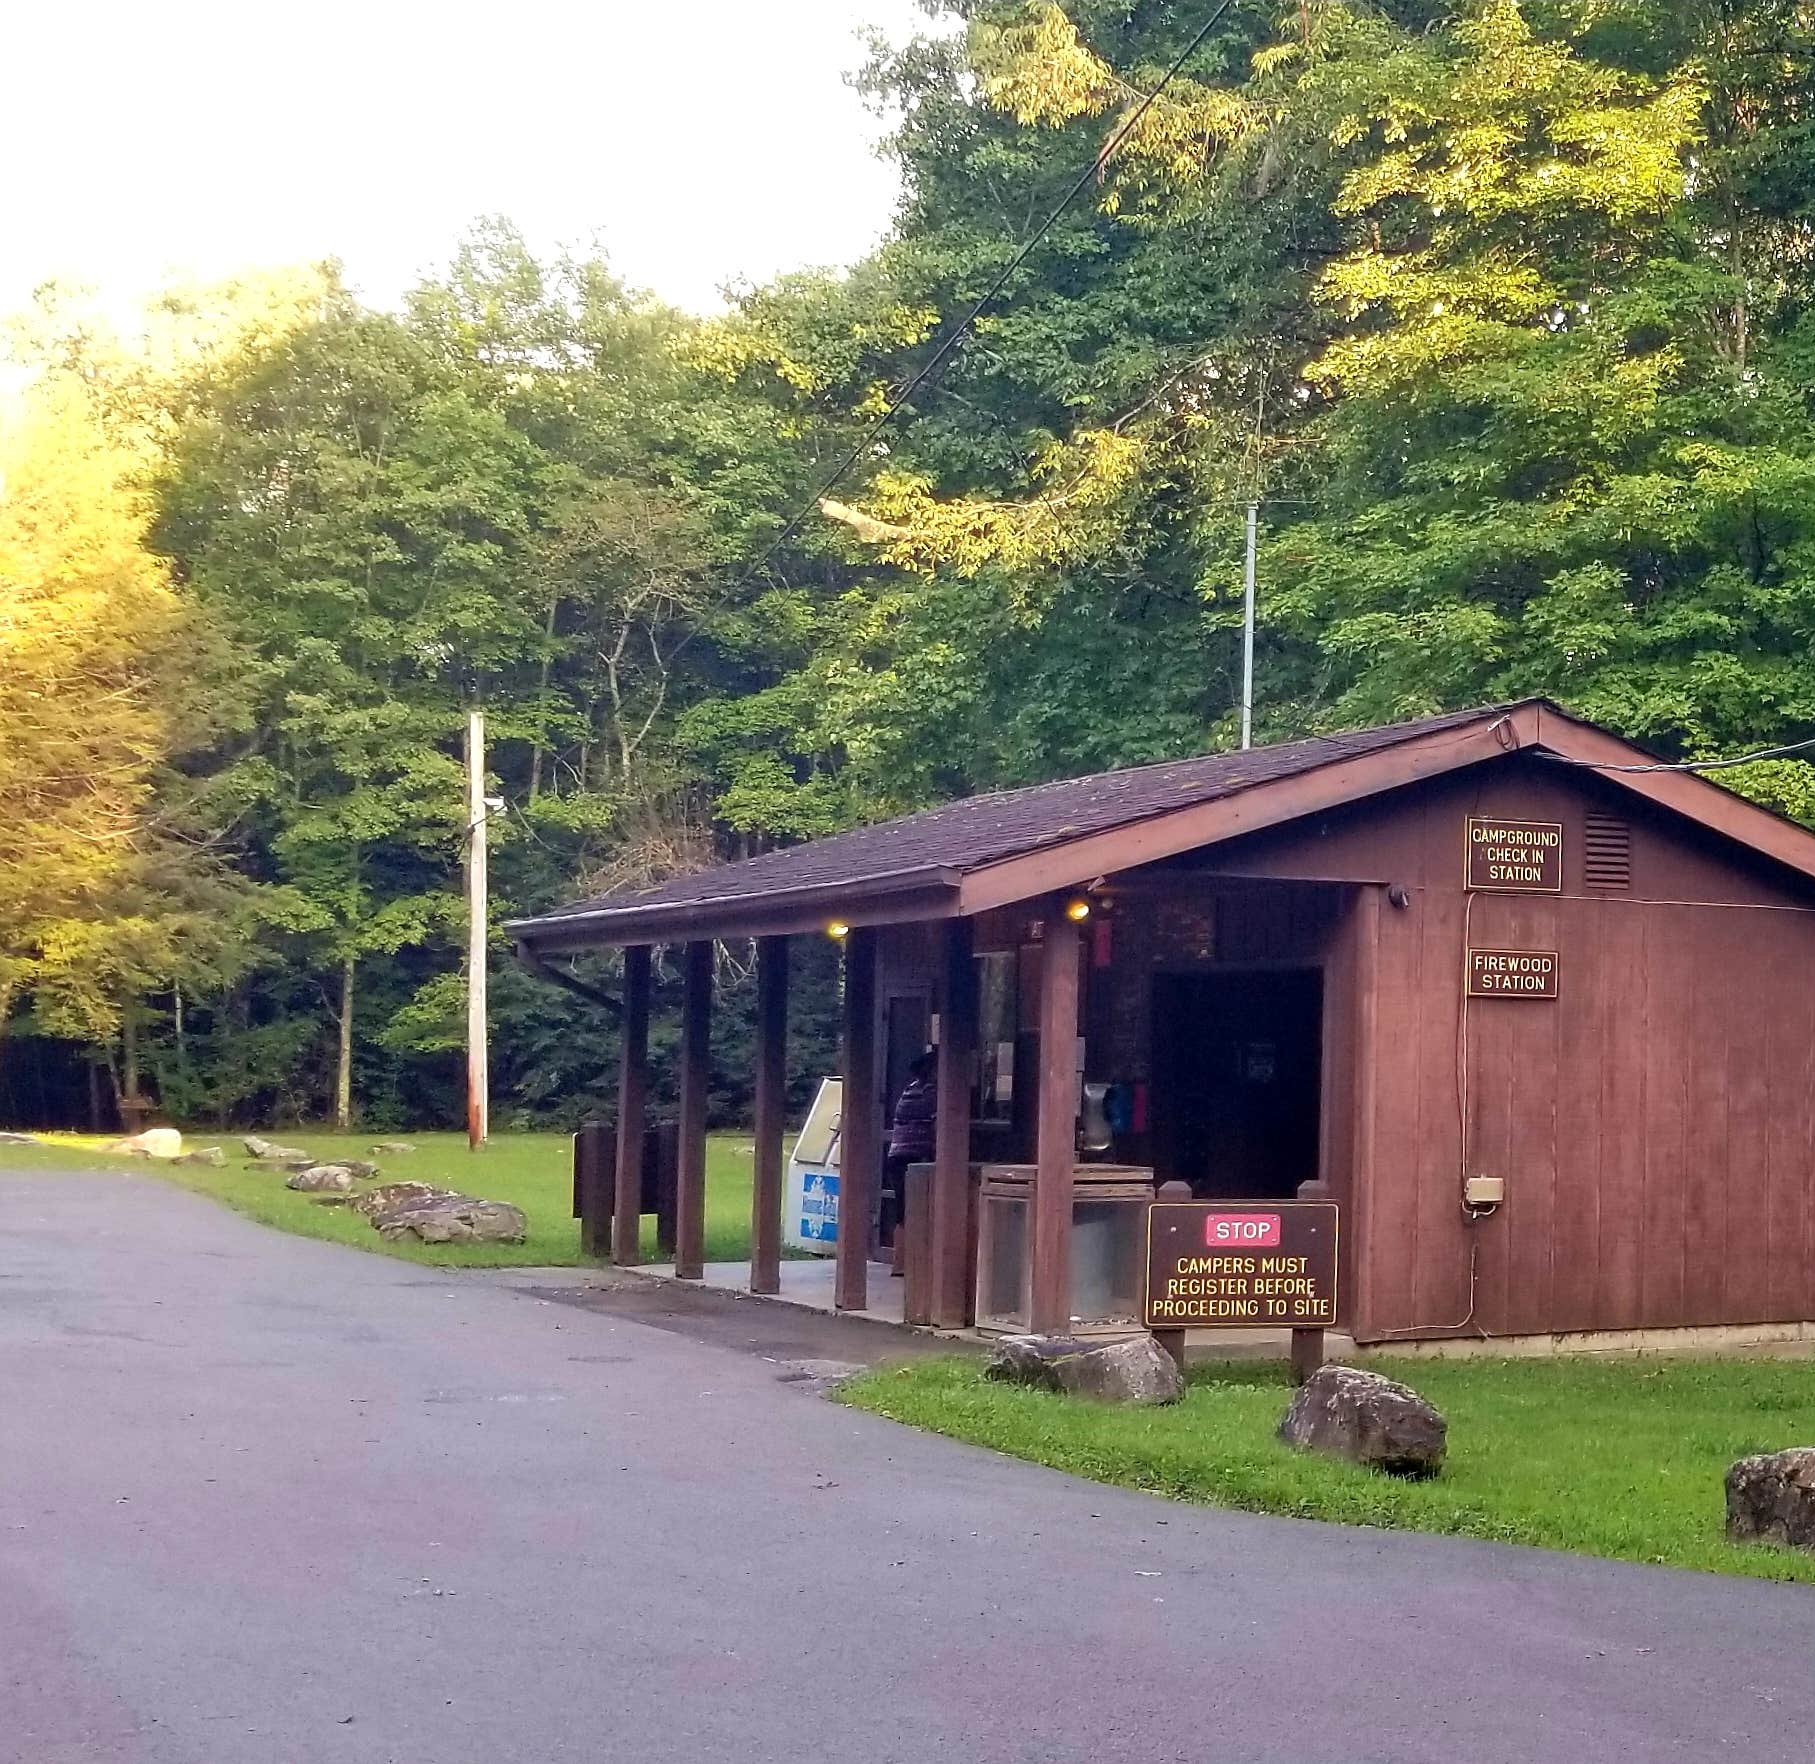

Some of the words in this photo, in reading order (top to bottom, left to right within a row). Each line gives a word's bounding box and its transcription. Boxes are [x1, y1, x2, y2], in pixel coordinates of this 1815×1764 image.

[1472, 828, 1559, 847] CAMPGROUND
[1487, 847, 1528, 863] CHECK
[1531, 848, 1545, 864] IN
[1489, 865, 1541, 881] STATION
[1474, 955, 1552, 972] FIREWOOD
[1482, 975, 1545, 990] STATION
[1215, 1221, 1271, 1239] STOP
[1177, 1257, 1256, 1274] CAMPERS
[1261, 1257, 1309, 1274] MUST
[1168, 1278, 1247, 1295] REGISTER
[1254, 1278, 1316, 1295] BEFORE
[1152, 1299, 1259, 1316] PROCEEDING
[1266, 1299, 1288, 1316] TO
[1294, 1299, 1329, 1316] SITE
